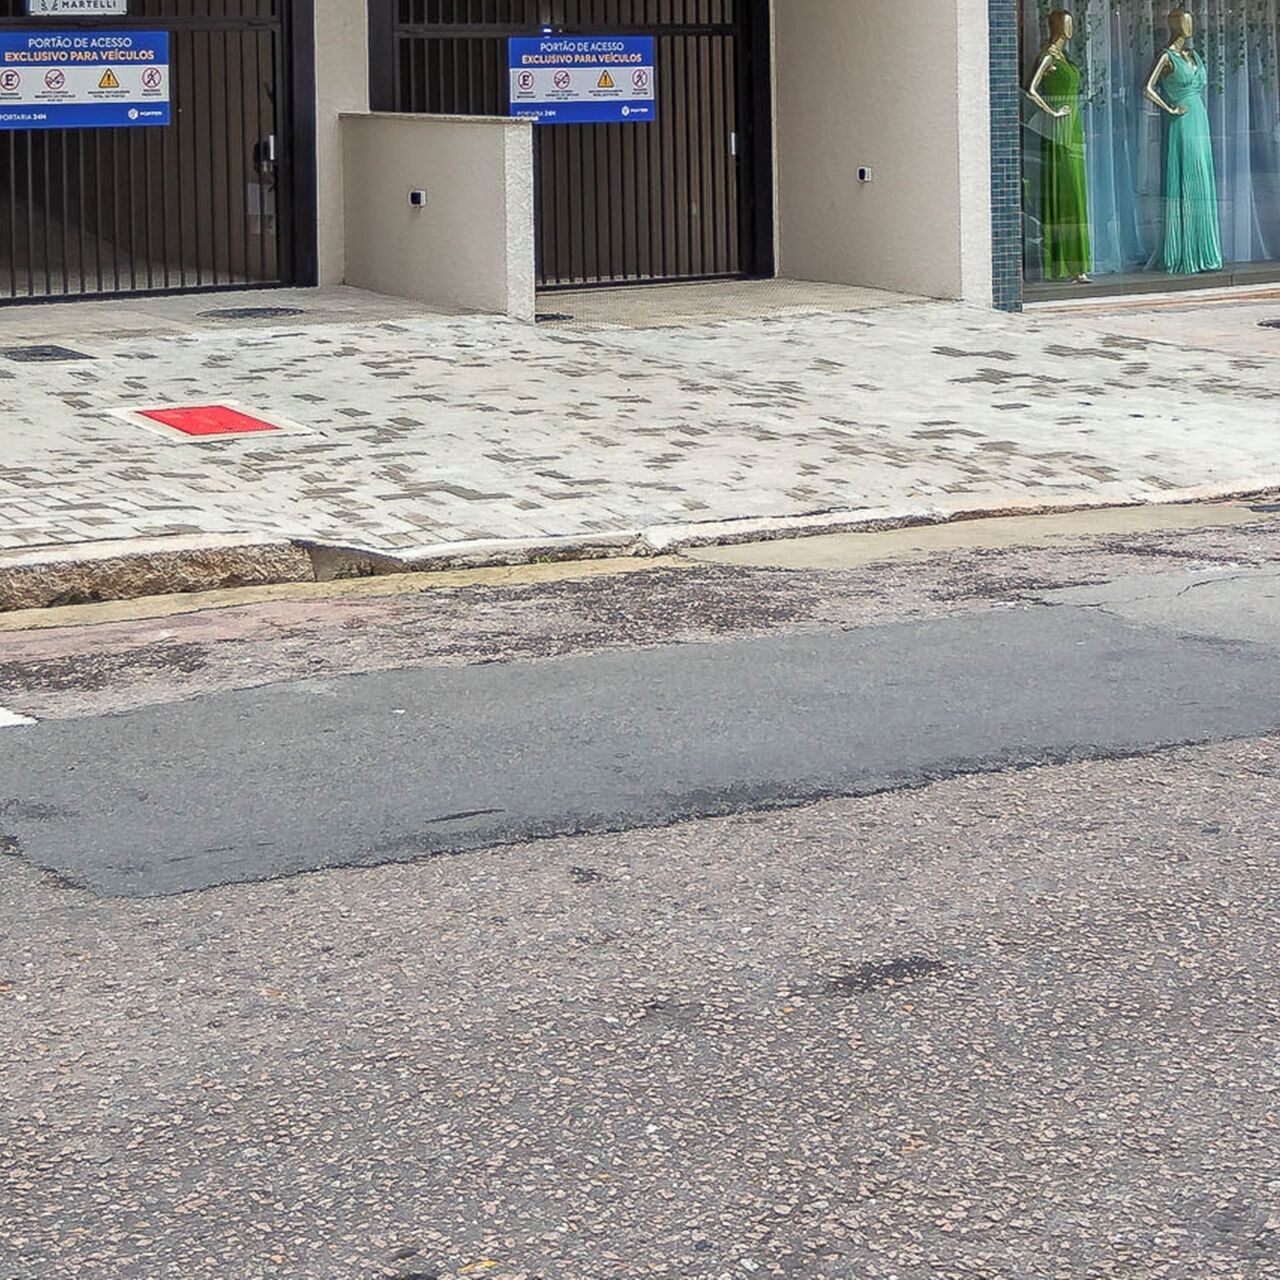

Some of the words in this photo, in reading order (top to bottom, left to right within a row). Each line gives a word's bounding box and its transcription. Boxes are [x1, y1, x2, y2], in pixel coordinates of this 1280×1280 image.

[62, 0, 116, 9] MARTELLI
[28, 36, 71, 49] PORTÃO
[74, 37, 88, 48] DE
[90, 37, 133, 48] ACESSO
[540, 41, 575, 52] PORTÃO
[577, 42, 588, 52] DE
[590, 42, 624, 52] ACESSO
[4, 51, 69, 62] EXCLUSIVO
[70, 50, 99, 62] PARA
[100, 48, 155, 61] VEÍCULOS
[522, 54, 573, 64] EXCLUSIVO
[575, 54, 597, 64] PARA
[599, 52, 642, 63] VEÍCULOS
